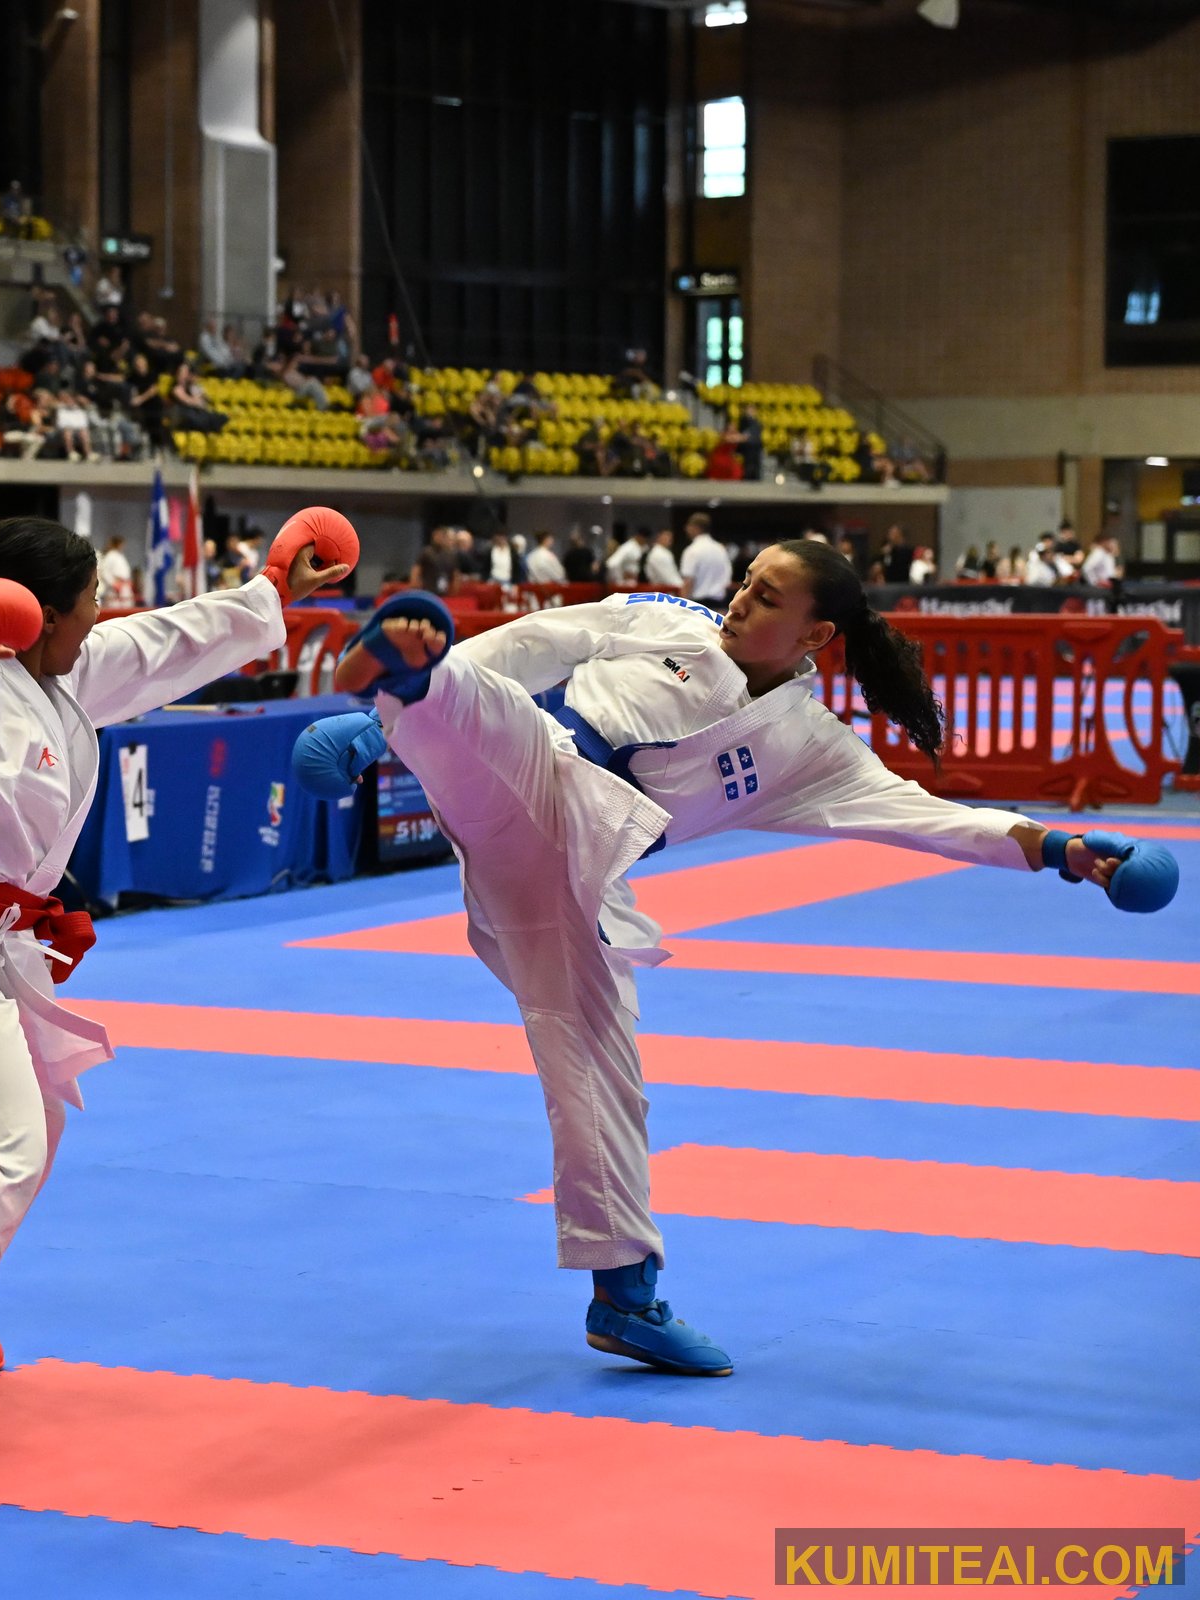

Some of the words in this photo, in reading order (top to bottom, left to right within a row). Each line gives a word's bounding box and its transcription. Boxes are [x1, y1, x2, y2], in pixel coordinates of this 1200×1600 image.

[625, 592, 724, 627] SMAI
[662, 657, 690, 683] SMAI
[132, 768, 144, 817] 4
